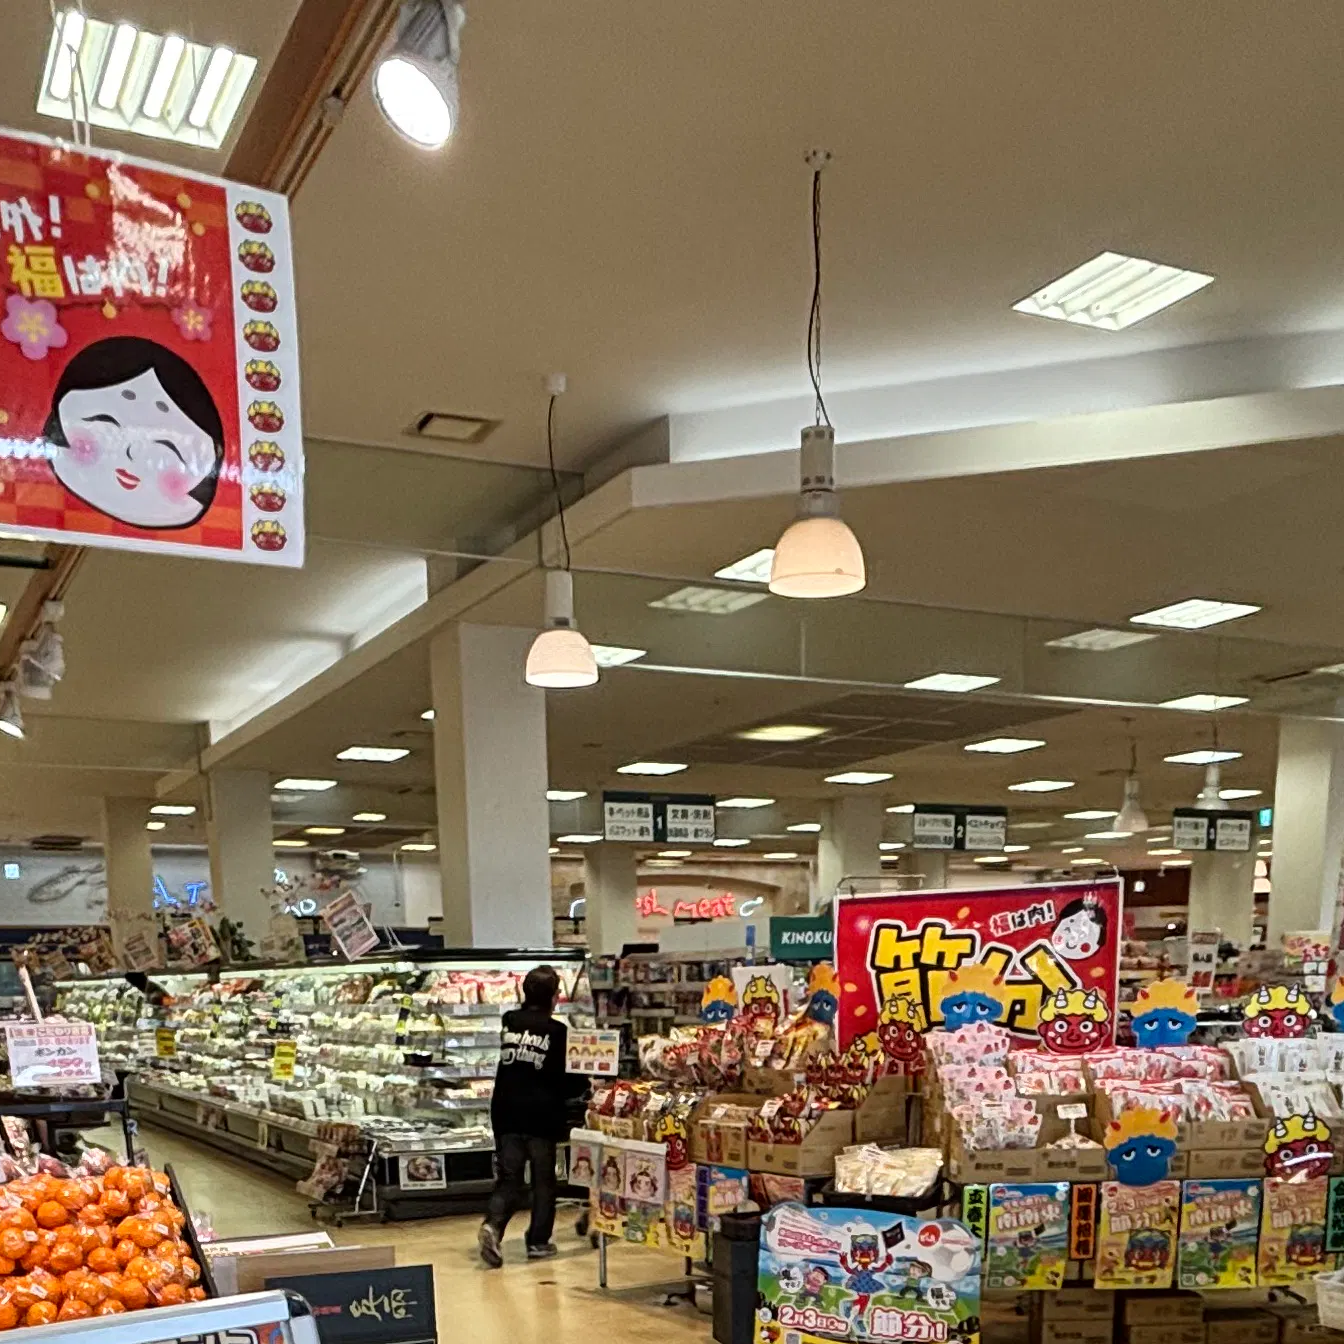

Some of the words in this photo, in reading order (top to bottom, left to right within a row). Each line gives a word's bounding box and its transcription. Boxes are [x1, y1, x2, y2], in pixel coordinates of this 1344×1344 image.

[656, 815, 663, 830] 1
[956, 825, 964, 839] 2
[875, 923, 1086, 1037] 節分
[871, 1307, 947, 1341] 節分！
